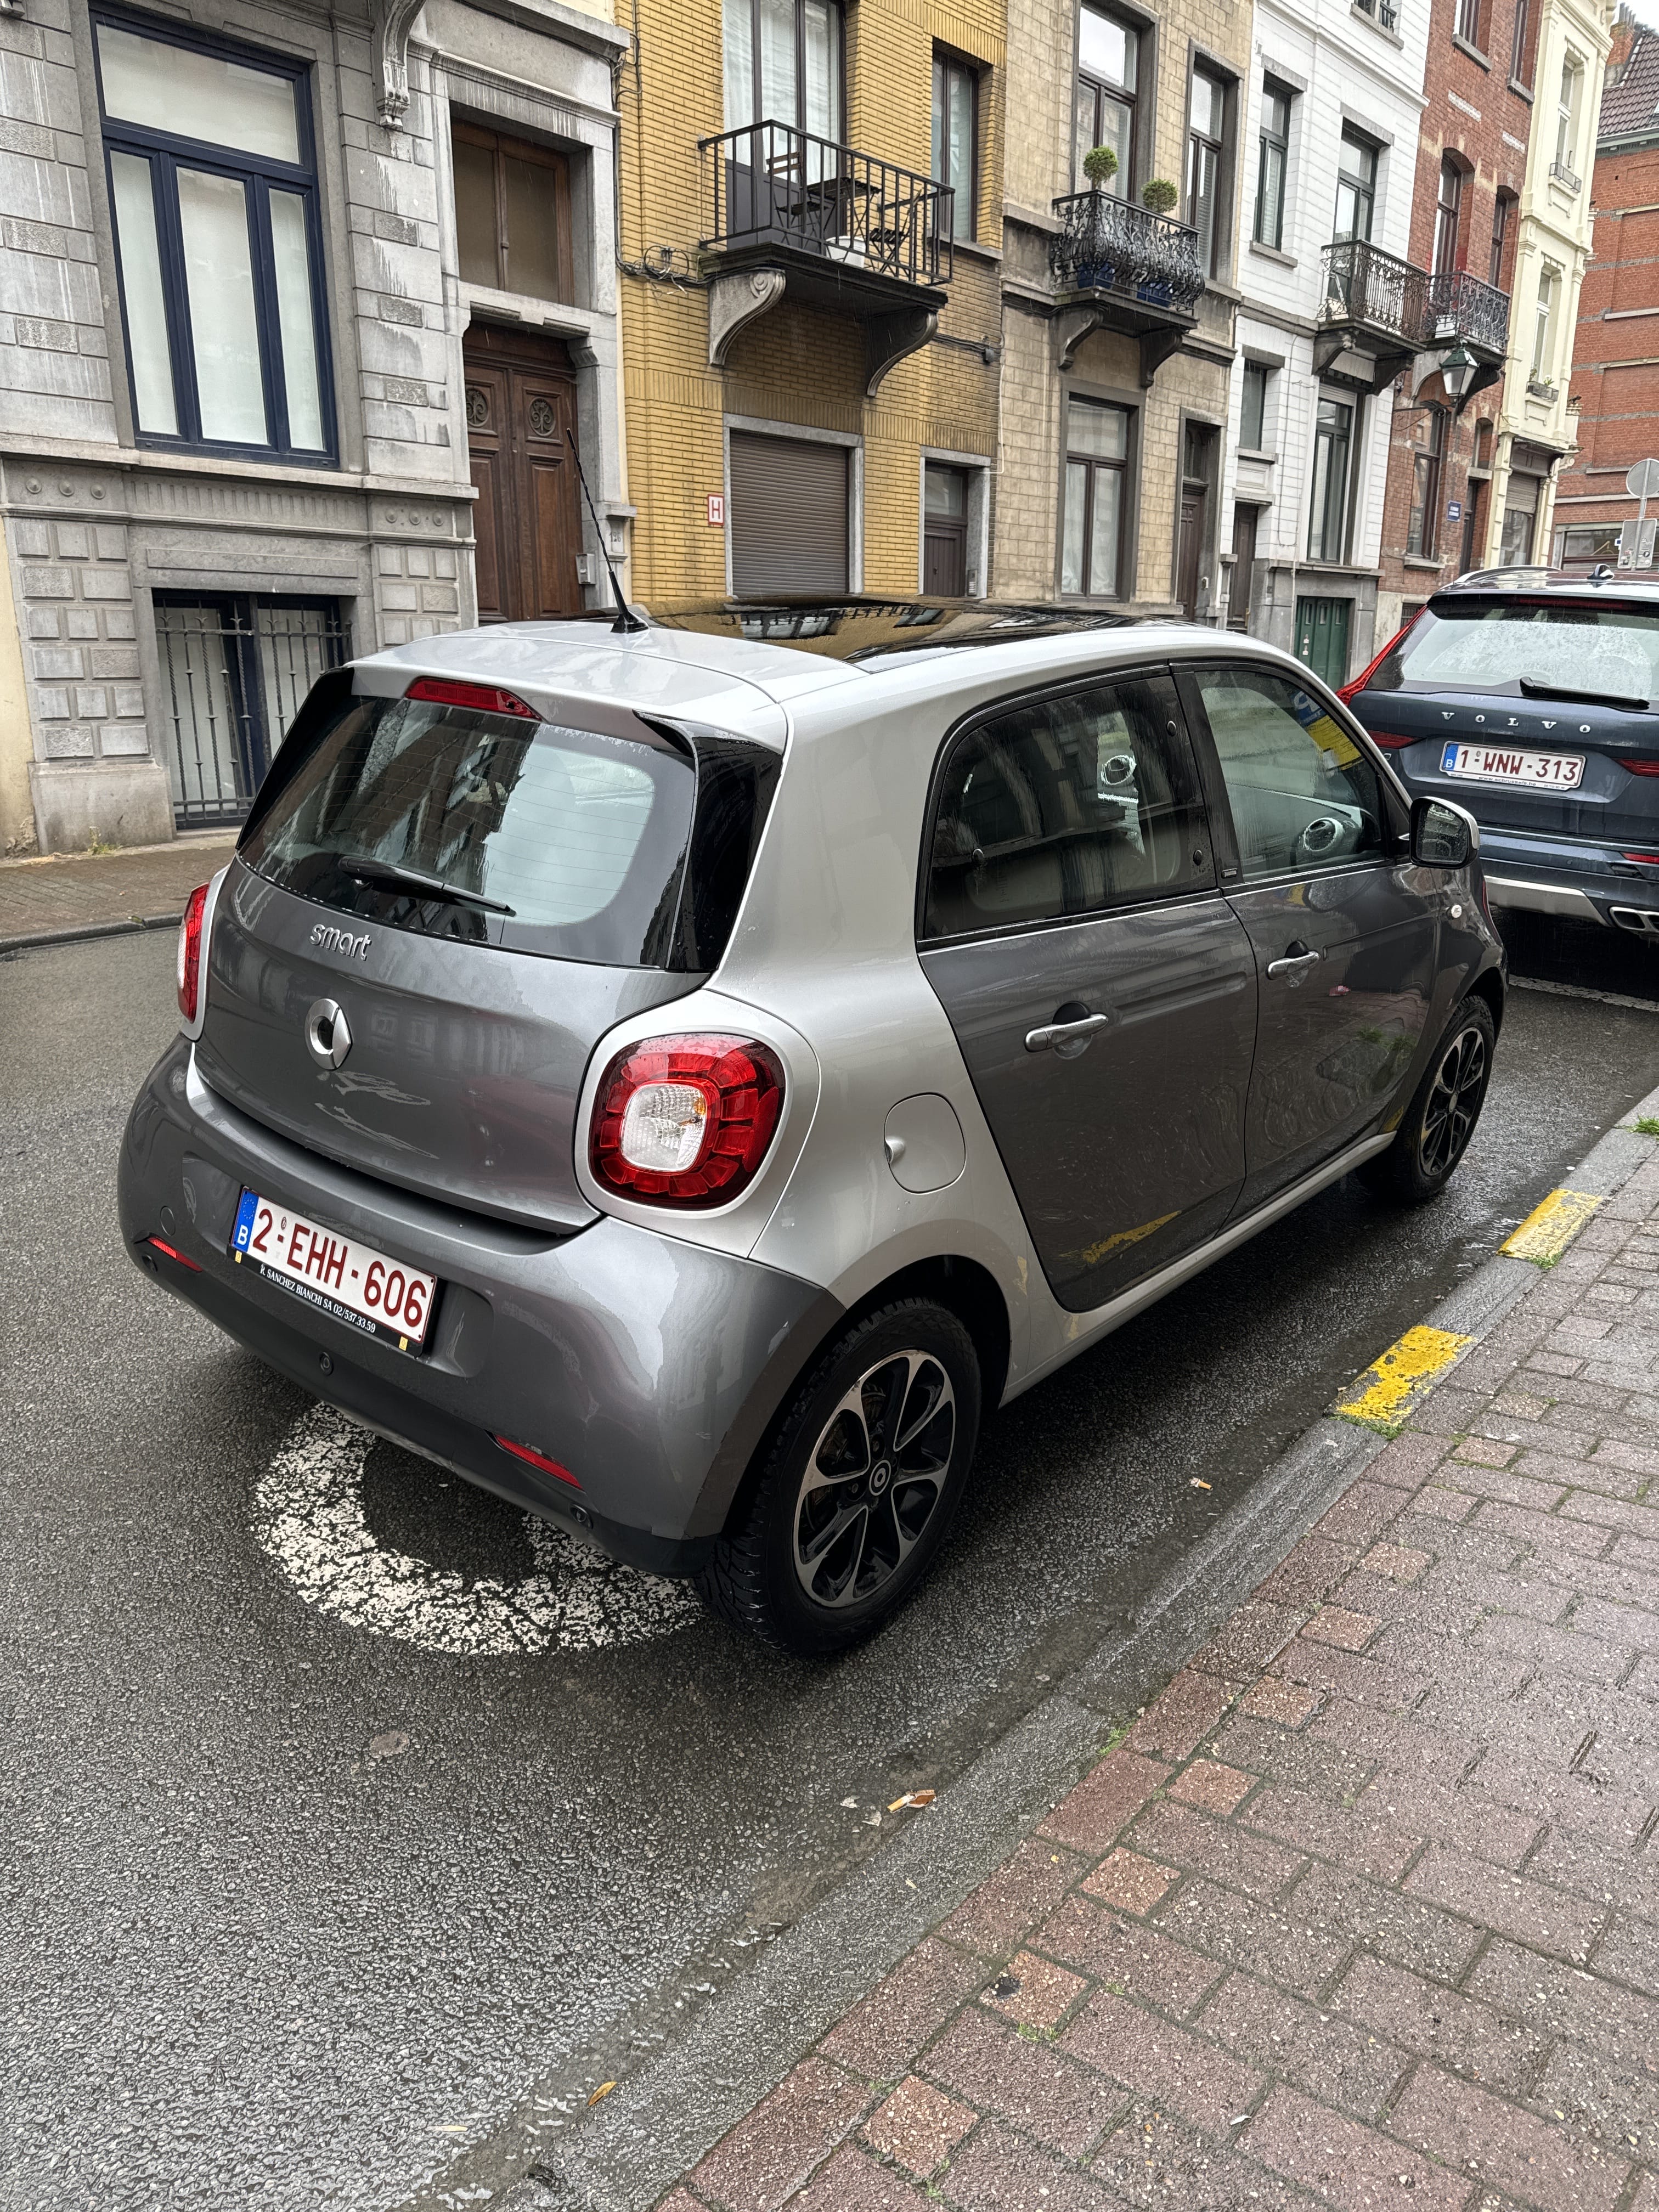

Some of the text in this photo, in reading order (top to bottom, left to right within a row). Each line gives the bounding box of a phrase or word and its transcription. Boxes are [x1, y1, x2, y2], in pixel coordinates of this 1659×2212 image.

[712, 500, 720, 520] H
[1441, 711, 1592, 733] VOLVO
[1445, 759, 1453, 769] B
[309, 923, 373, 961] smart
[237, 1224, 249, 1245] B
[267, 1269, 296, 1291] SANCHEZ
[296, 1284, 323, 1306] BIANCHI
[323, 1299, 332, 1311] SA
[333, 1304, 376, 1334] 02/537.33.59
